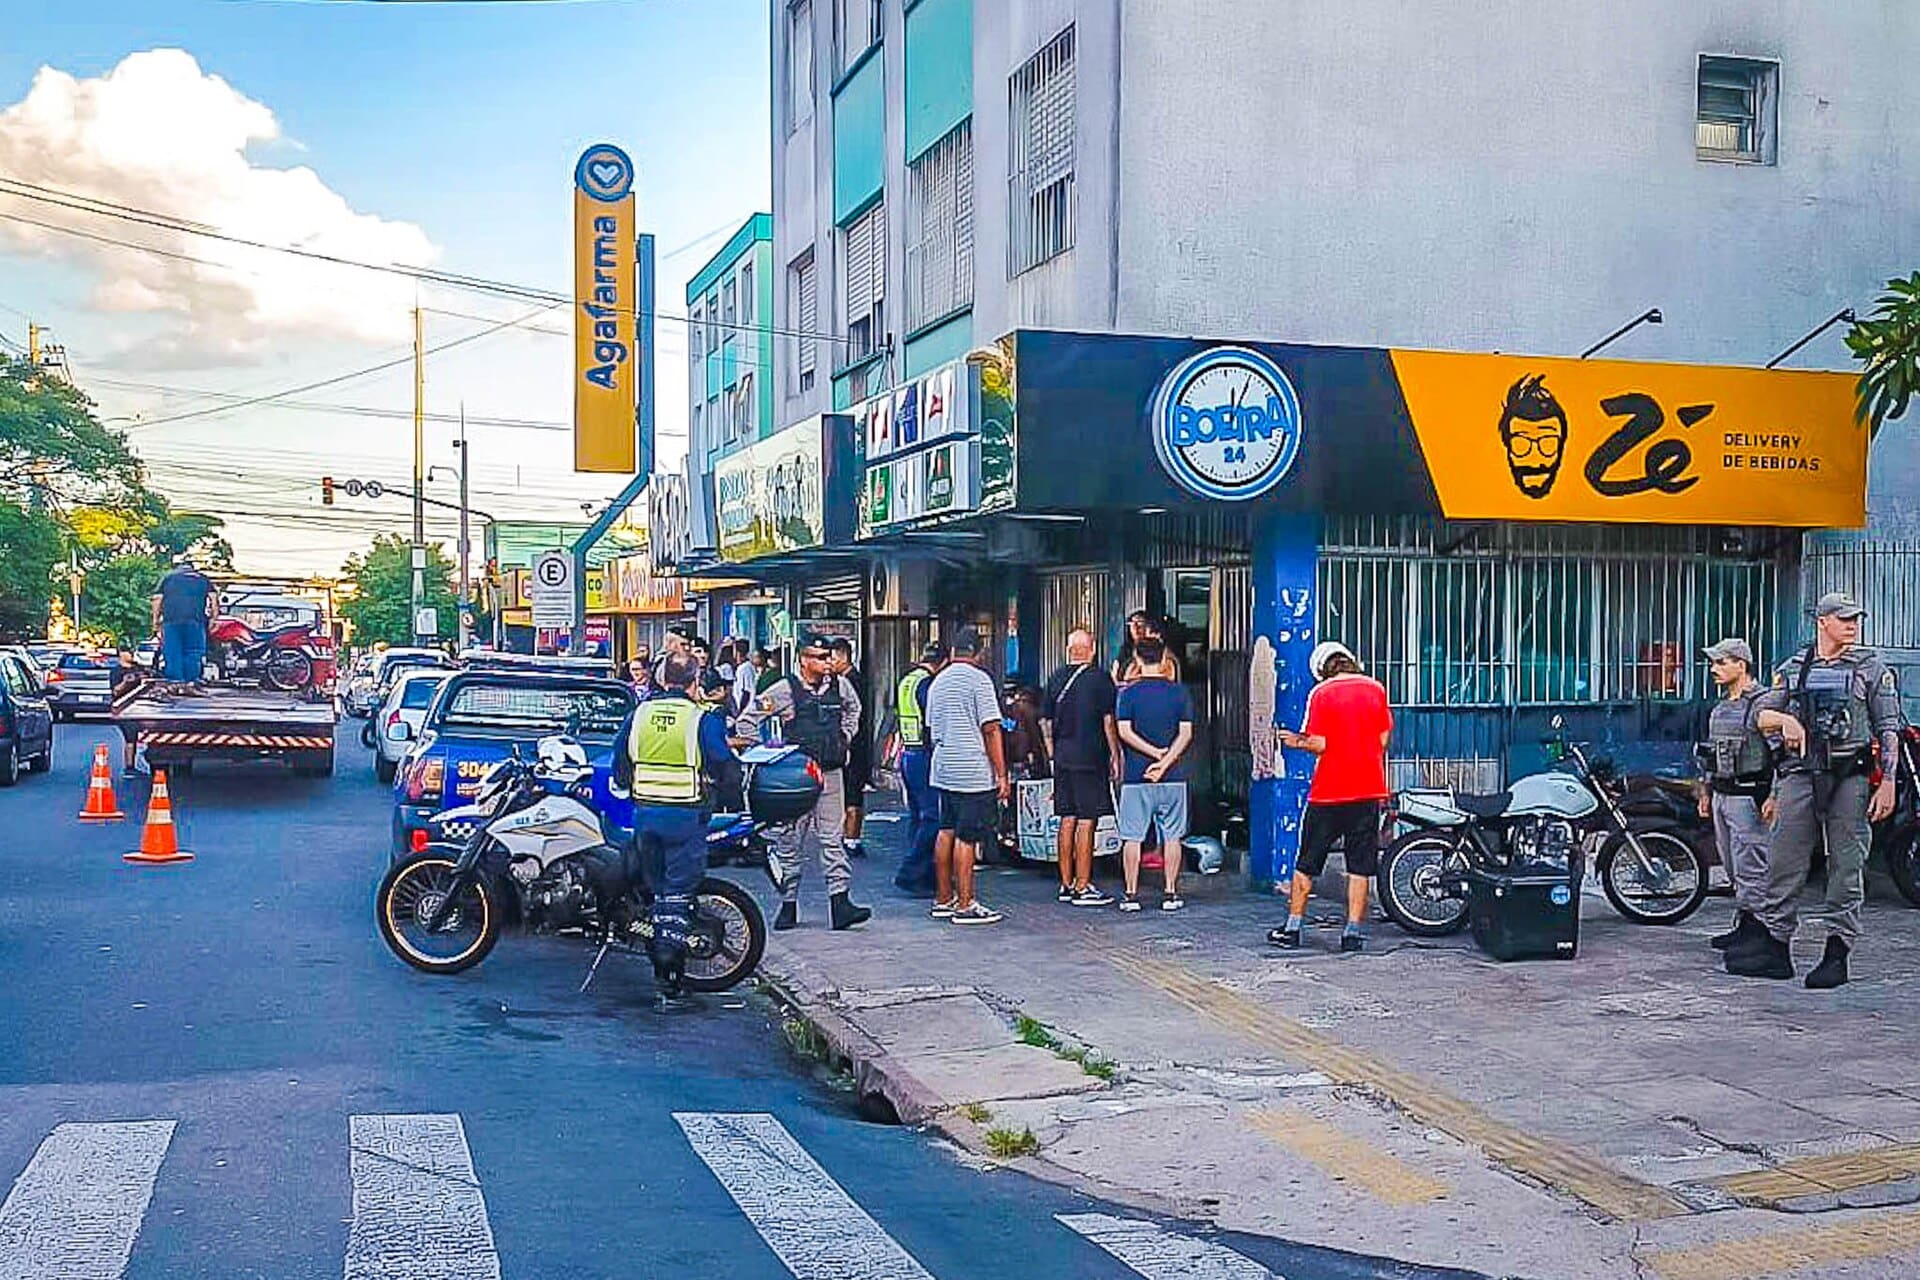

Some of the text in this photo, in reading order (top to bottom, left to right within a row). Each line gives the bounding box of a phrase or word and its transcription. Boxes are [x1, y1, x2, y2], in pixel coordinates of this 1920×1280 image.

[583, 215, 627, 389] Agafarma
[1173, 395, 1292, 446] BOEIRA
[1584, 393, 1715, 496] Zé
[1724, 433, 1801, 448] DELIVERY
[1223, 446, 1246, 463] 24
[1723, 455, 1820, 471] DE BEBIDAS
[546, 564, 559, 581] E
